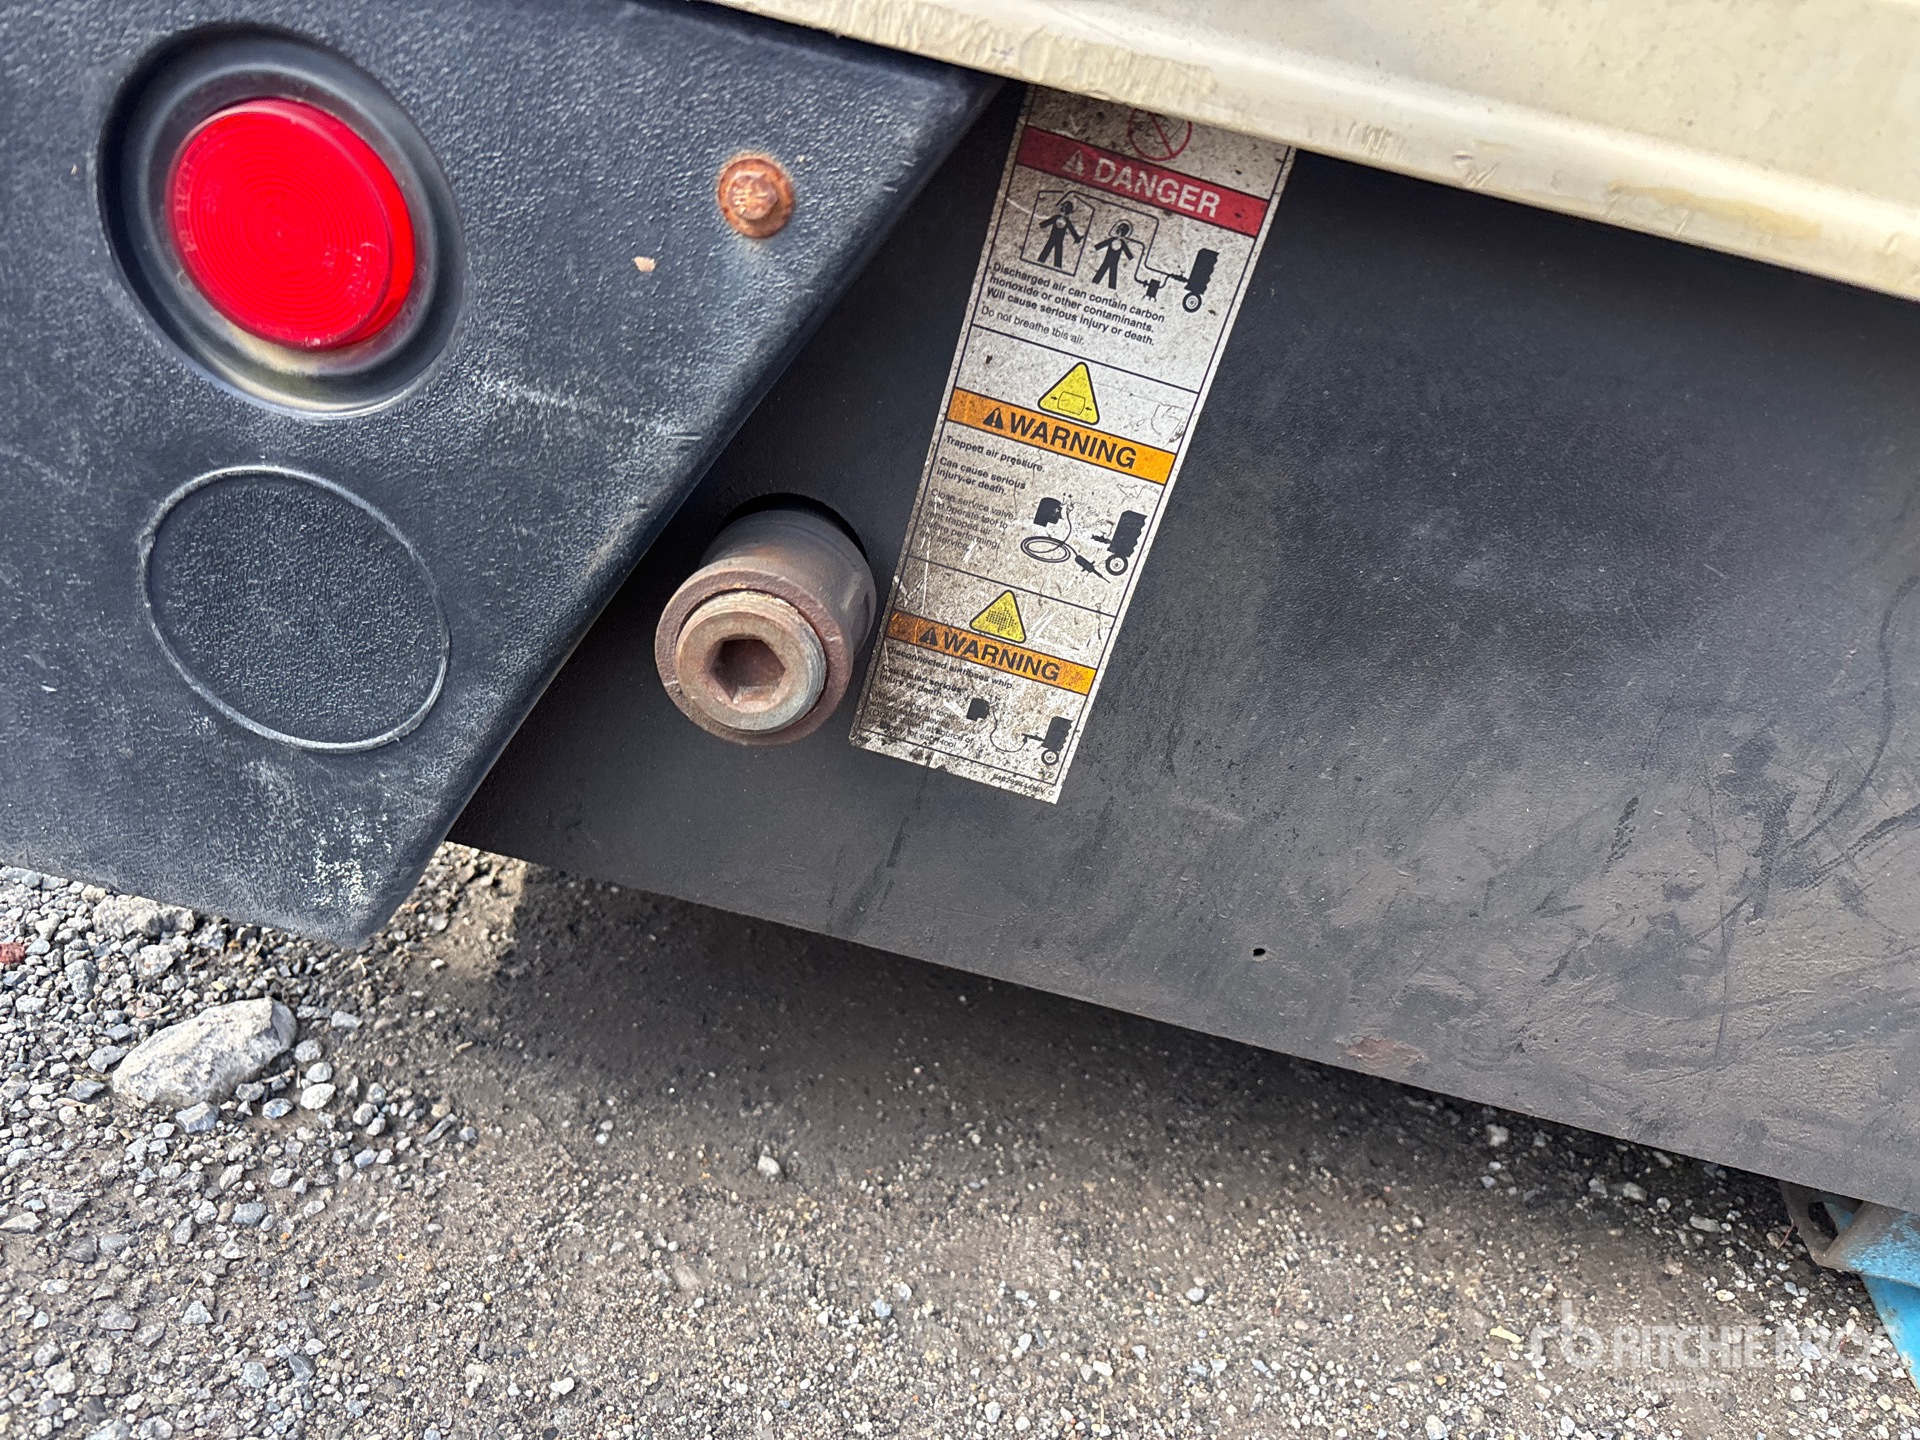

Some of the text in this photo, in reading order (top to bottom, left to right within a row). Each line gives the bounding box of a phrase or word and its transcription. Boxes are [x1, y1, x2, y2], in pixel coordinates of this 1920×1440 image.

[1092, 157, 1221, 218] DANGER
[989, 276, 1155, 333] monoxide or other contaminants.
[992, 261, 1165, 323] Discharged air can contain carbon
[981, 305, 996, 318] Do
[997, 312, 1013, 324] not
[1013, 314, 1051, 335] breathe
[986, 286, 1155, 347] Will cause serious injury or death.
[946, 435, 1045, 473] Trapped air pressure.
[1010, 412, 1138, 470] WARNING
[936, 468, 1007, 495] injury or death.
[940, 456, 1026, 490] Can cause serious
[931, 488, 956, 503] Close
[958, 497, 989, 512] service
[945, 515, 979, 532] trapped
[980, 526, 992, 535] air
[946, 505, 980, 520] operate
[1000, 521, 1009, 529] to
[951, 528, 998, 550] performing
[887, 646, 948, 670] Disconnected
[943, 630, 1062, 682] WARNING
[880, 673, 905, 686] injury
[906, 681, 916, 689] or
